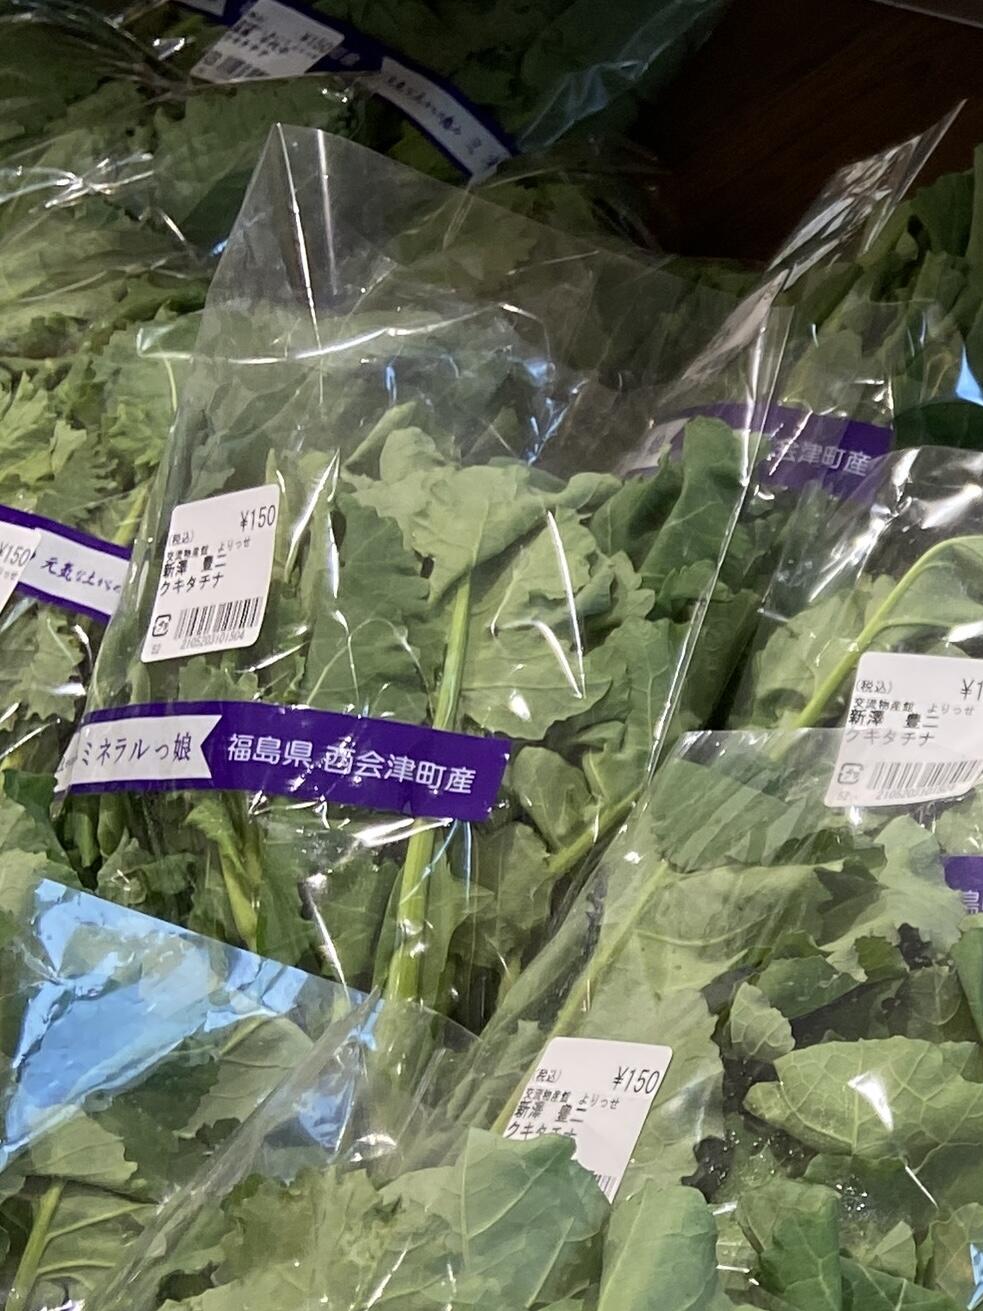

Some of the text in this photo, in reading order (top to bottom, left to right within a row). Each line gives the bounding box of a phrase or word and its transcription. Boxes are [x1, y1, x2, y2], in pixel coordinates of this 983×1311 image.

[240, 504, 276, 532] ¥150
[159, 572, 225, 597] クキタチナ
[856, 679, 893, 694] (税込)
[845, 729, 936, 748] クキタチナ
[81, 732, 193, 766] ミネラルっ娘
[227, 733, 313, 769] 福島県
[322, 743, 477, 795] 西会津町産
[613, 1066, 660, 1095] ¥150
